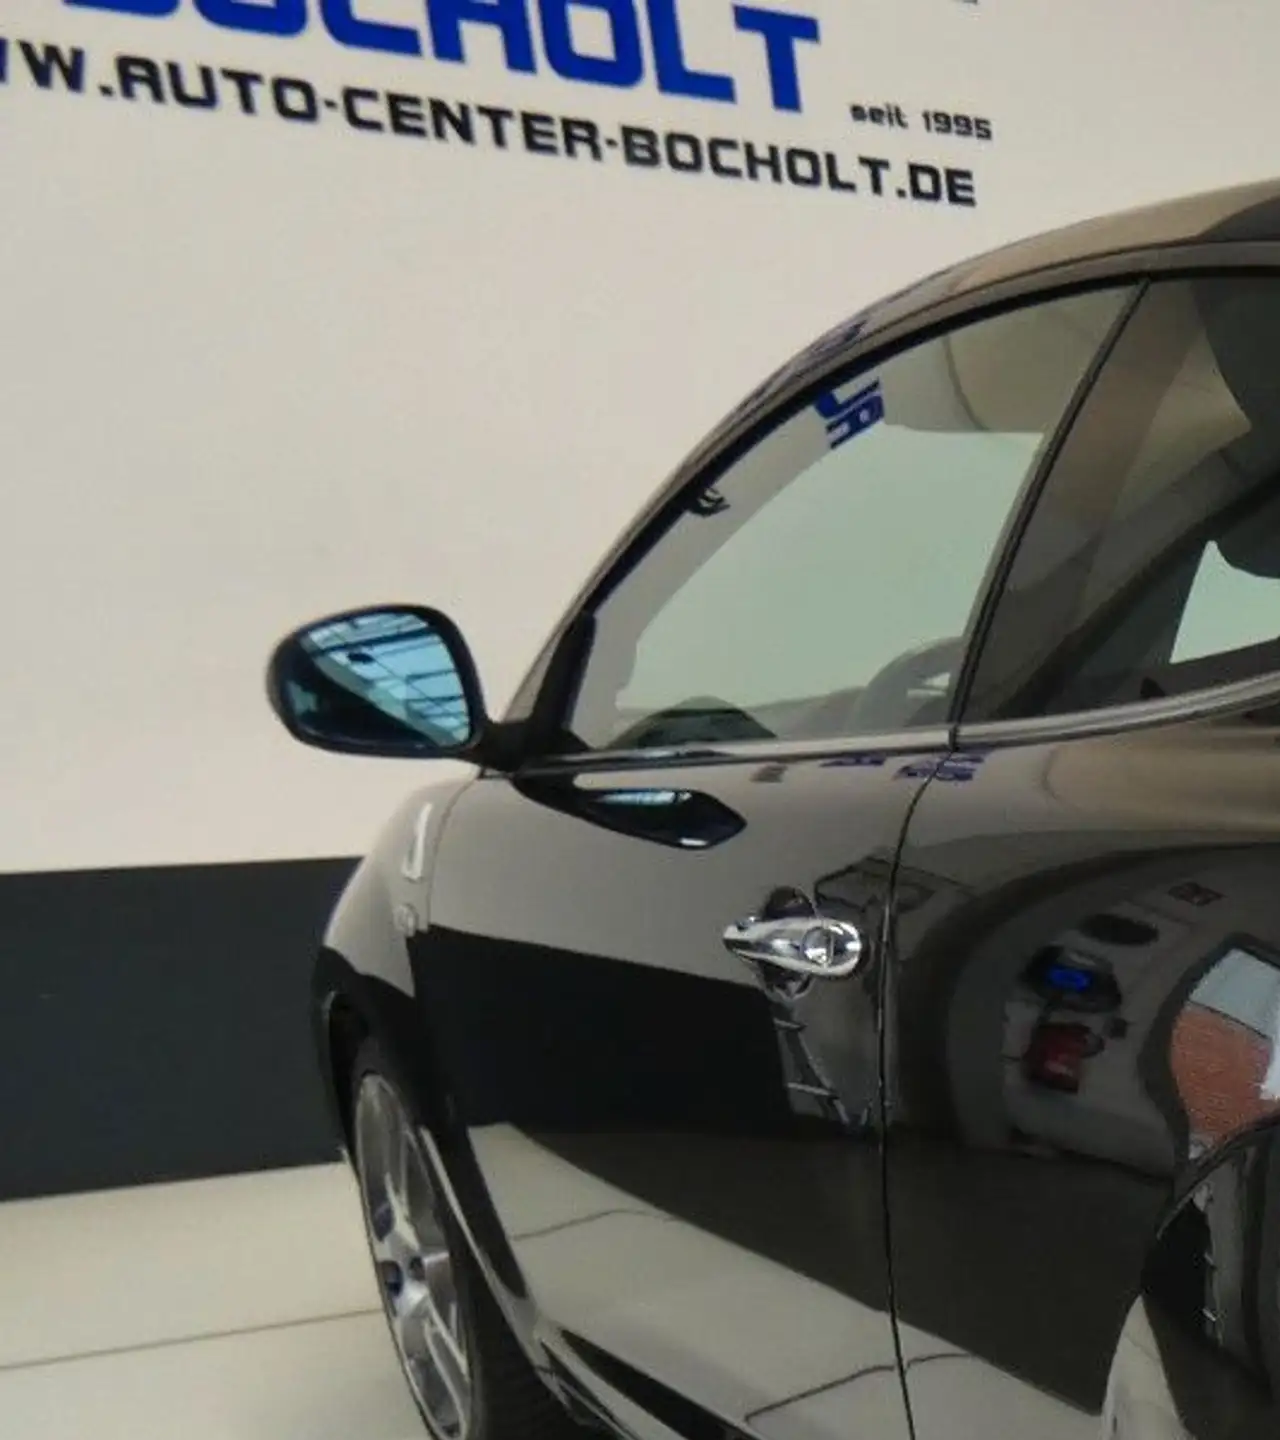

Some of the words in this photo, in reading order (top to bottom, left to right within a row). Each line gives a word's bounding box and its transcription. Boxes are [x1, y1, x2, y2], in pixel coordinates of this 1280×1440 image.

[0, 36, 977, 207] W.AUTO-CENTER-BOCHOLT.DE
[850, 103, 909, 130] seit
[921, 110, 993, 141] 1995
